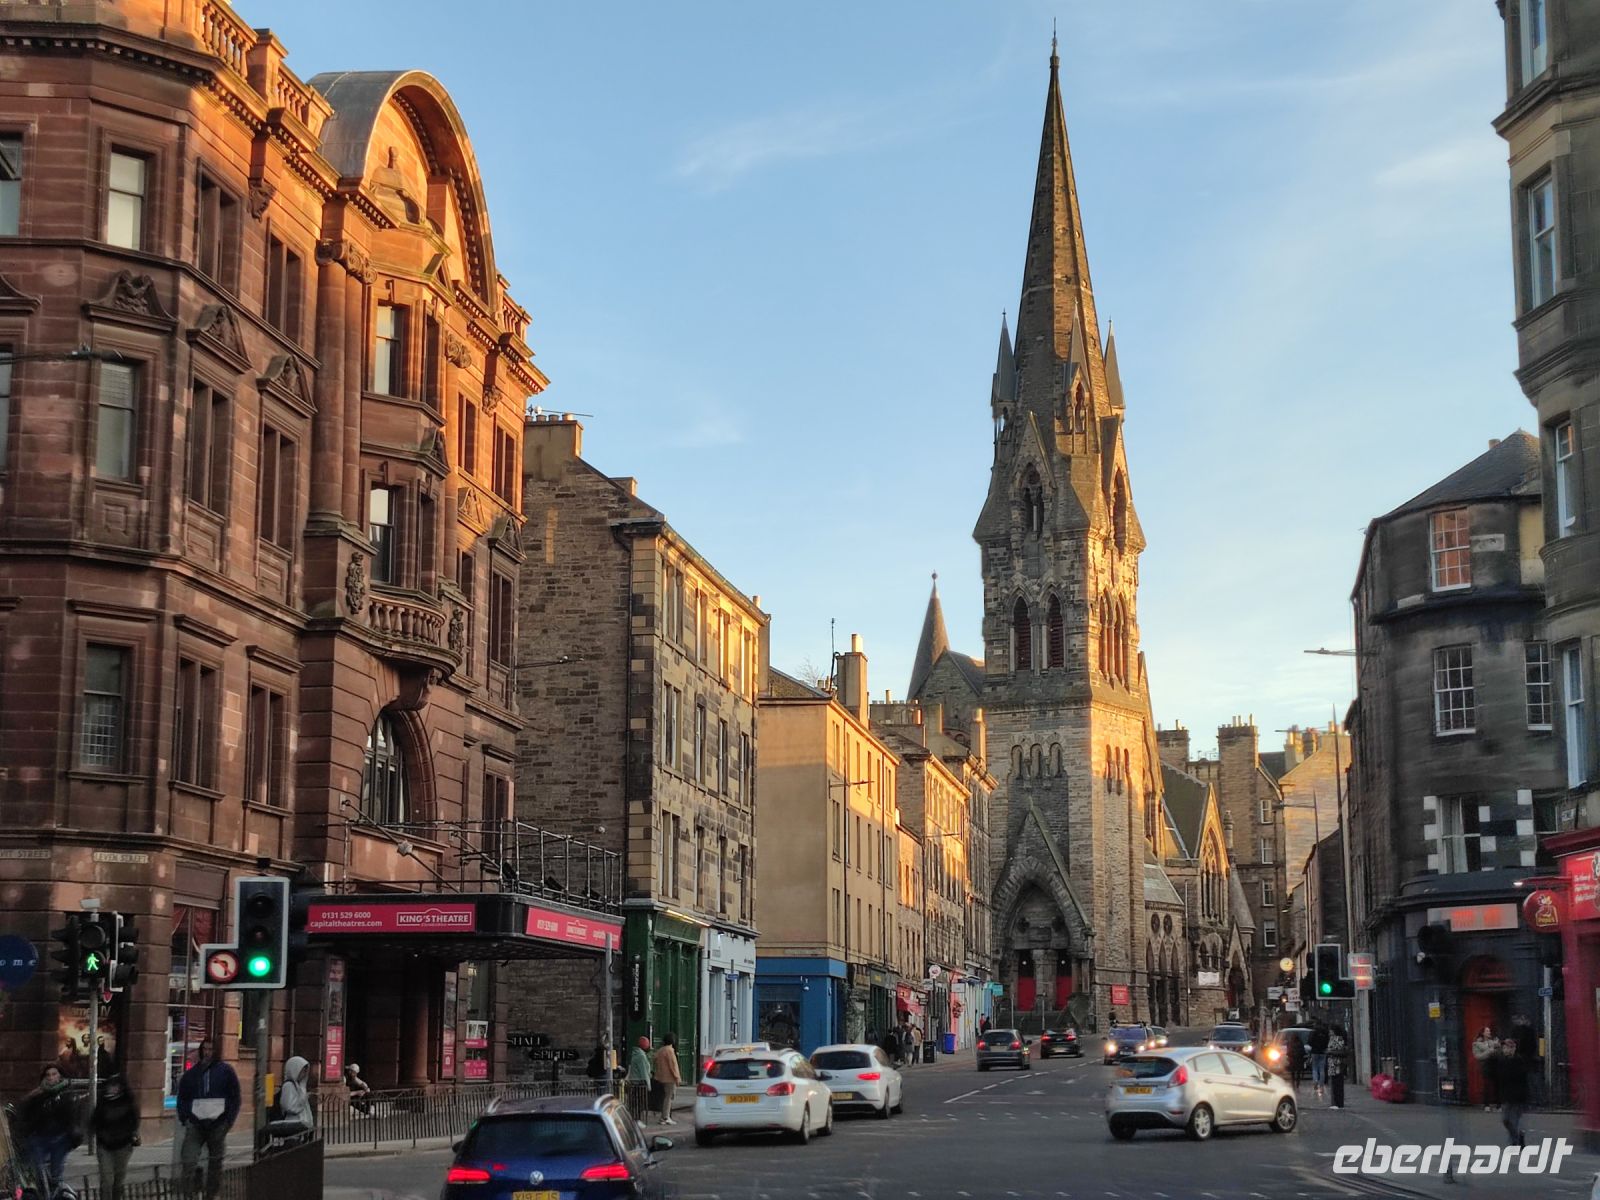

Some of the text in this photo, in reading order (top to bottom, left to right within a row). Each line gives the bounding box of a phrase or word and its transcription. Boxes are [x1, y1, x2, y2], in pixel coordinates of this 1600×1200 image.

[399, 915, 469, 923] KING'S THEATRE
[310, 920, 382, 928] capitaltheatres.com
